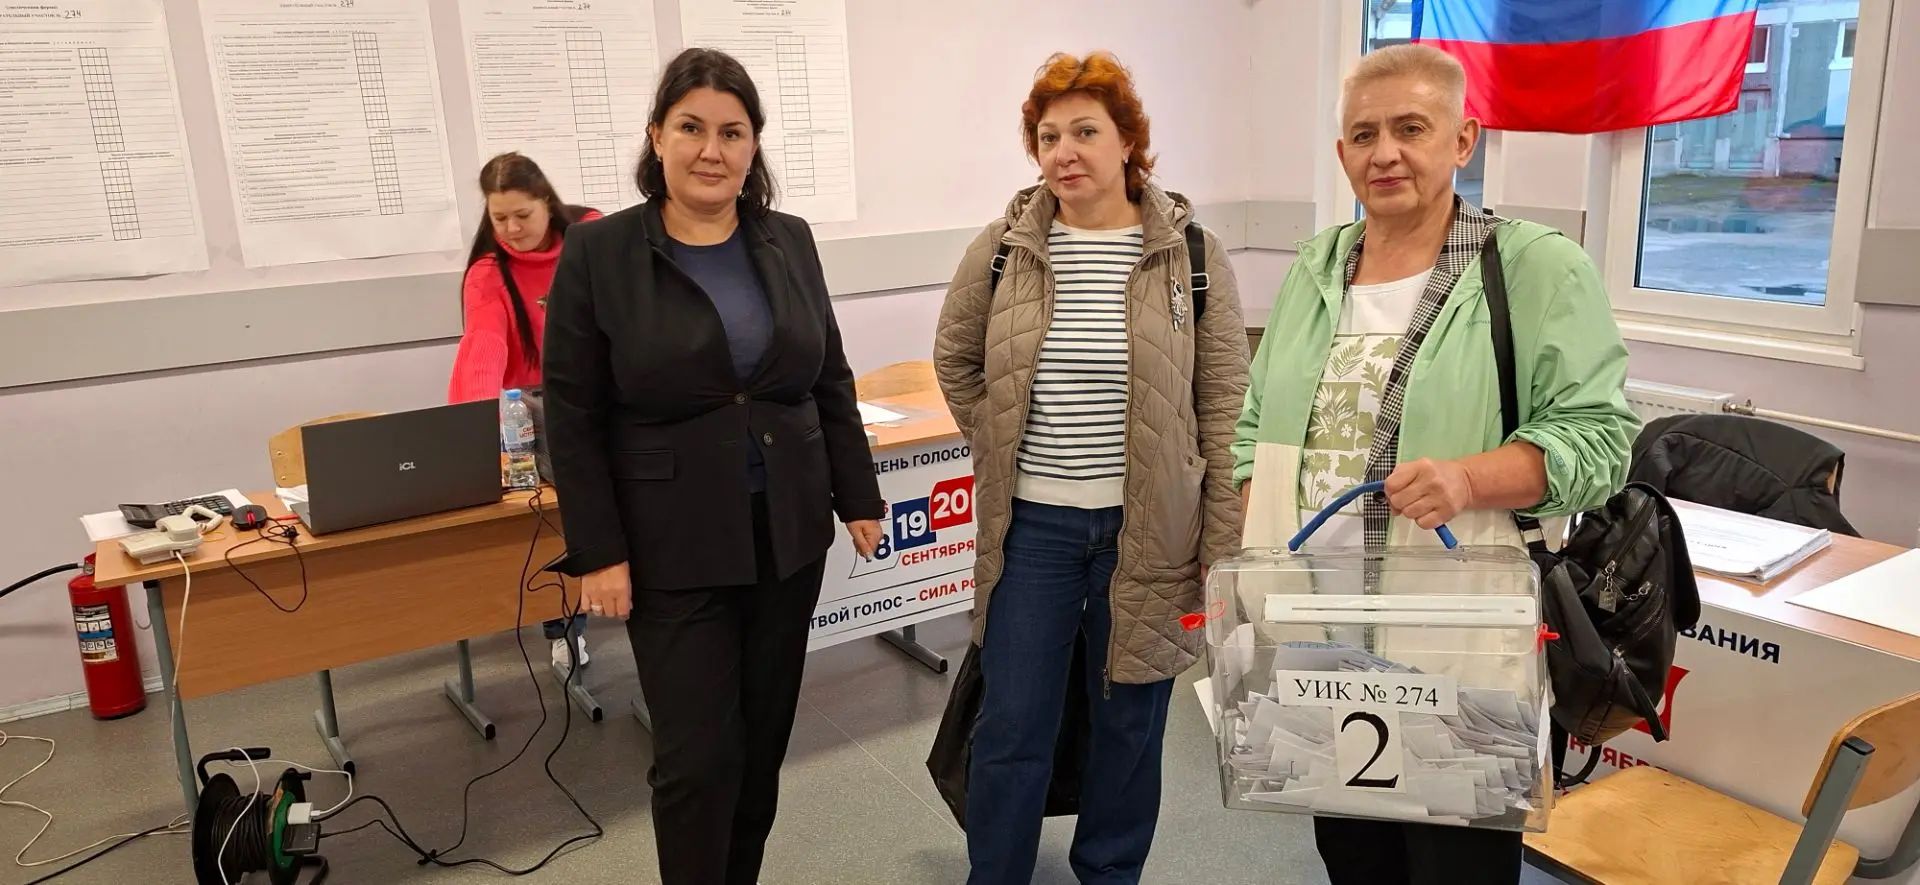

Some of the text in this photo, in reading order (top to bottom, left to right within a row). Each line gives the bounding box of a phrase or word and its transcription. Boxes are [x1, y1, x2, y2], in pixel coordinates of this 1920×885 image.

[912, 446, 971, 467] ГОЛОСО
[896, 510, 927, 541] 19
[933, 488, 970, 520] 20
[901, 539, 976, 566] СЕНТЯБРЯ
[810, 606, 850, 630] ТВОЙ
[853, 595, 903, 619] ГОЛОС
[919, 583, 958, 601] СИЛА
[961, 578, 976, 592] РО
[1680, 624, 1780, 664] ВАНИЯ
[1294, 678, 1439, 707] УИК № 274
[1340, 711, 1400, 789] 2
